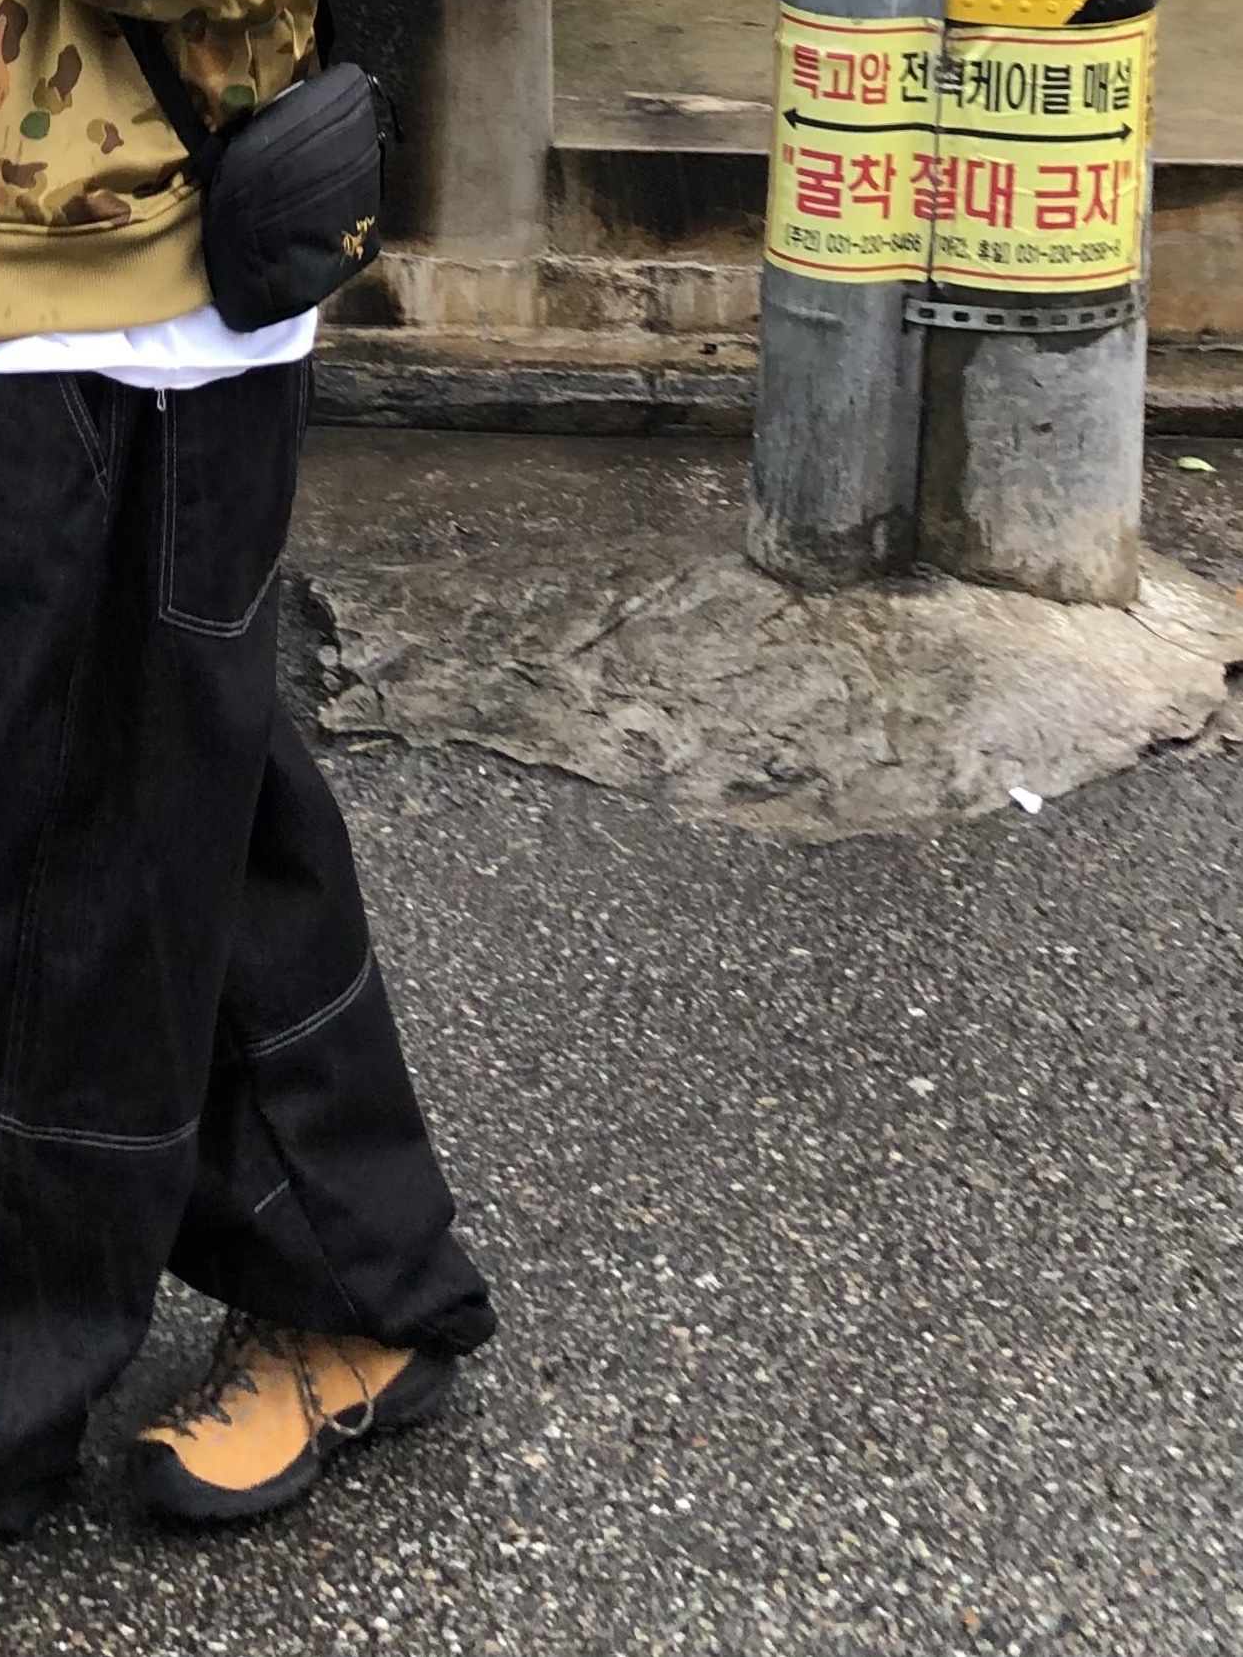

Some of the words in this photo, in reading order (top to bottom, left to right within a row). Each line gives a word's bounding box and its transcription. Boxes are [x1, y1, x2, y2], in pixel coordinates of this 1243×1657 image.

[792, 43, 891, 106] 특고압
[1083, 57, 1133, 111] 매설
[910, 151, 1015, 229] 절대
